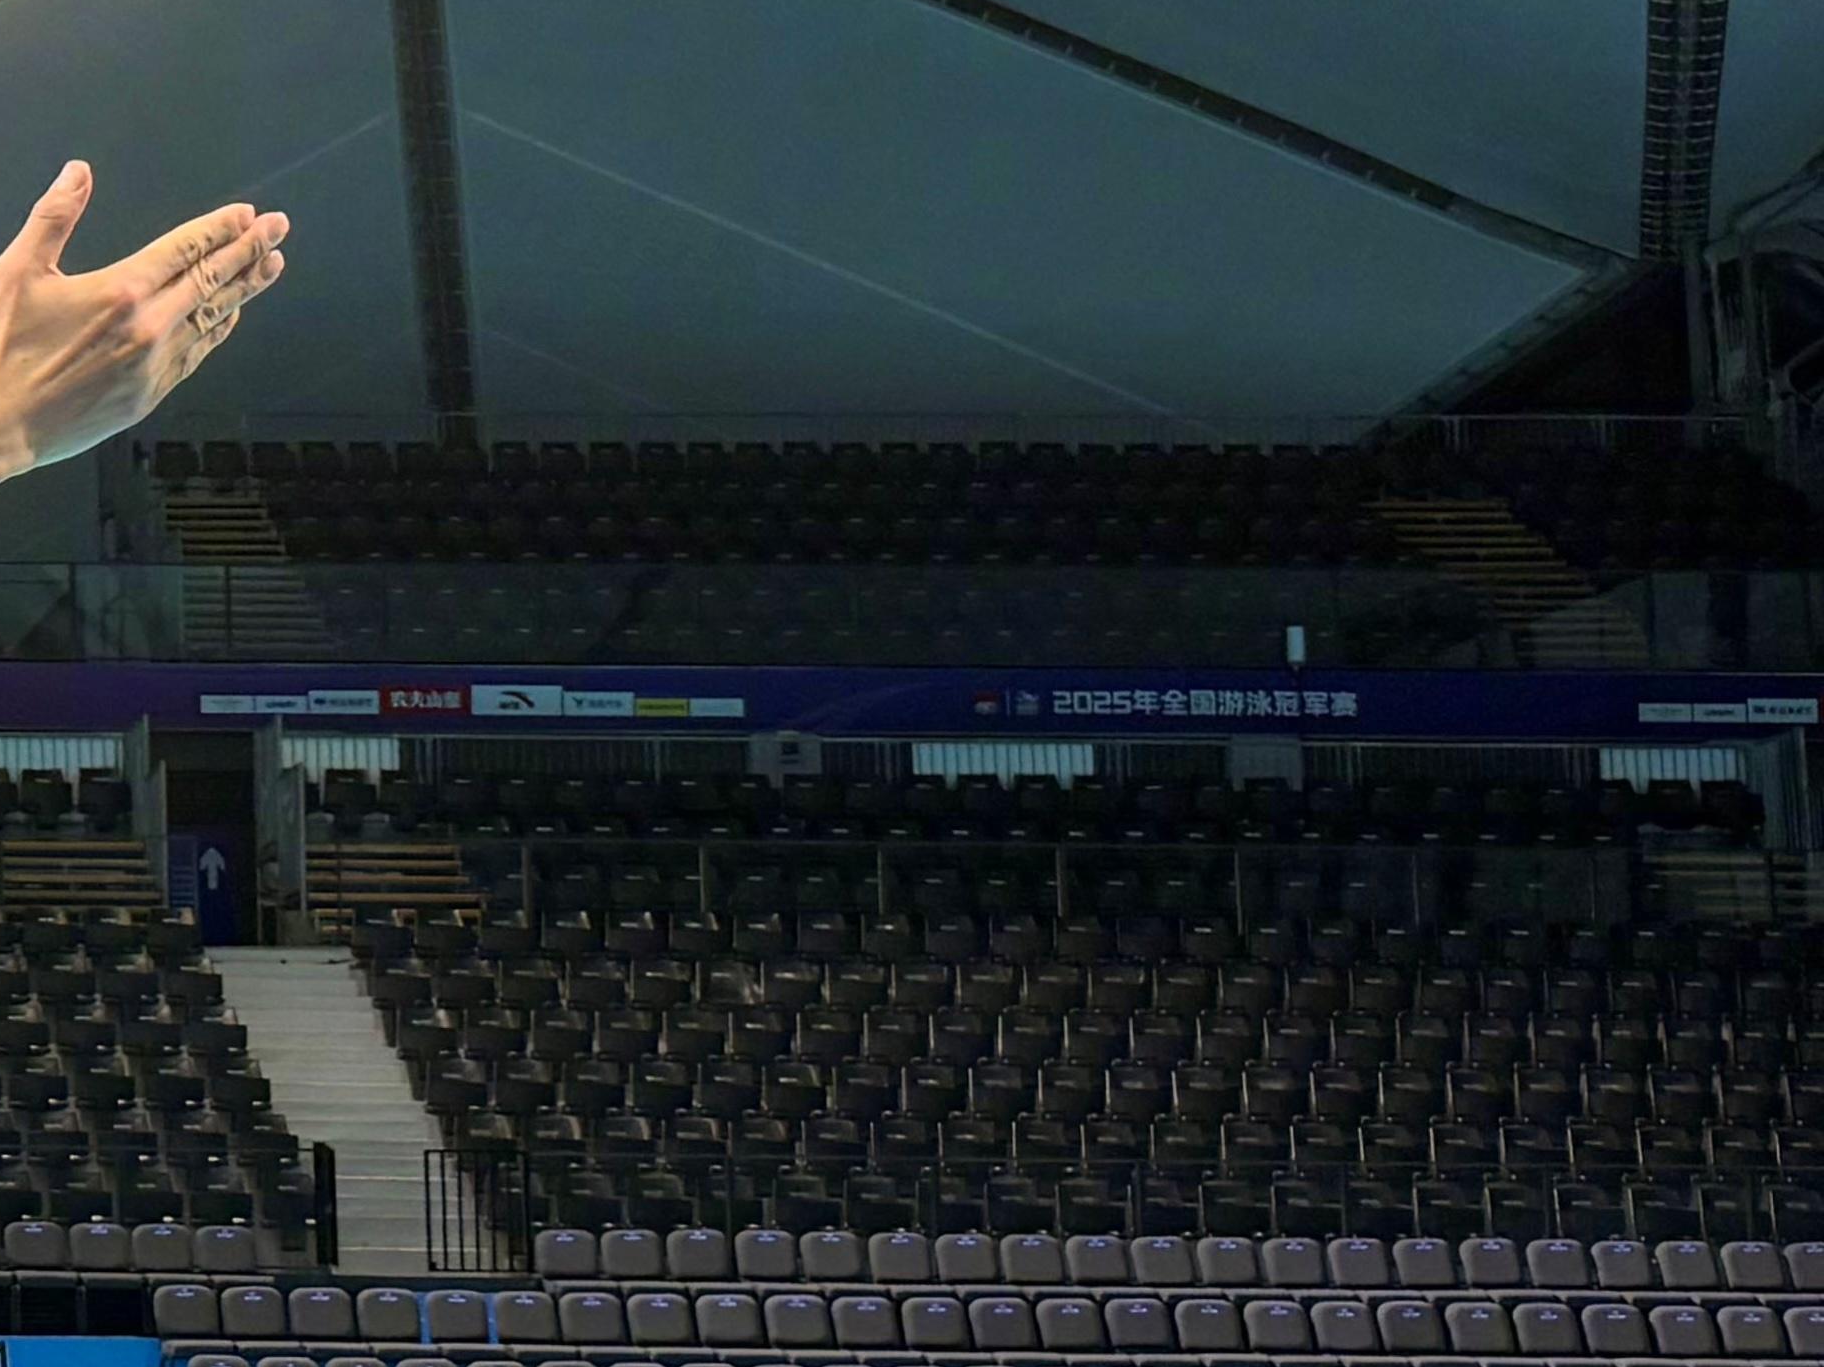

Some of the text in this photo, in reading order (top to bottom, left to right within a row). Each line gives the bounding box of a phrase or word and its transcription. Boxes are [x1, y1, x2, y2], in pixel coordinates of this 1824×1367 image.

[1051, 689, 1358, 718] 2025年全国游泳冠军赛
